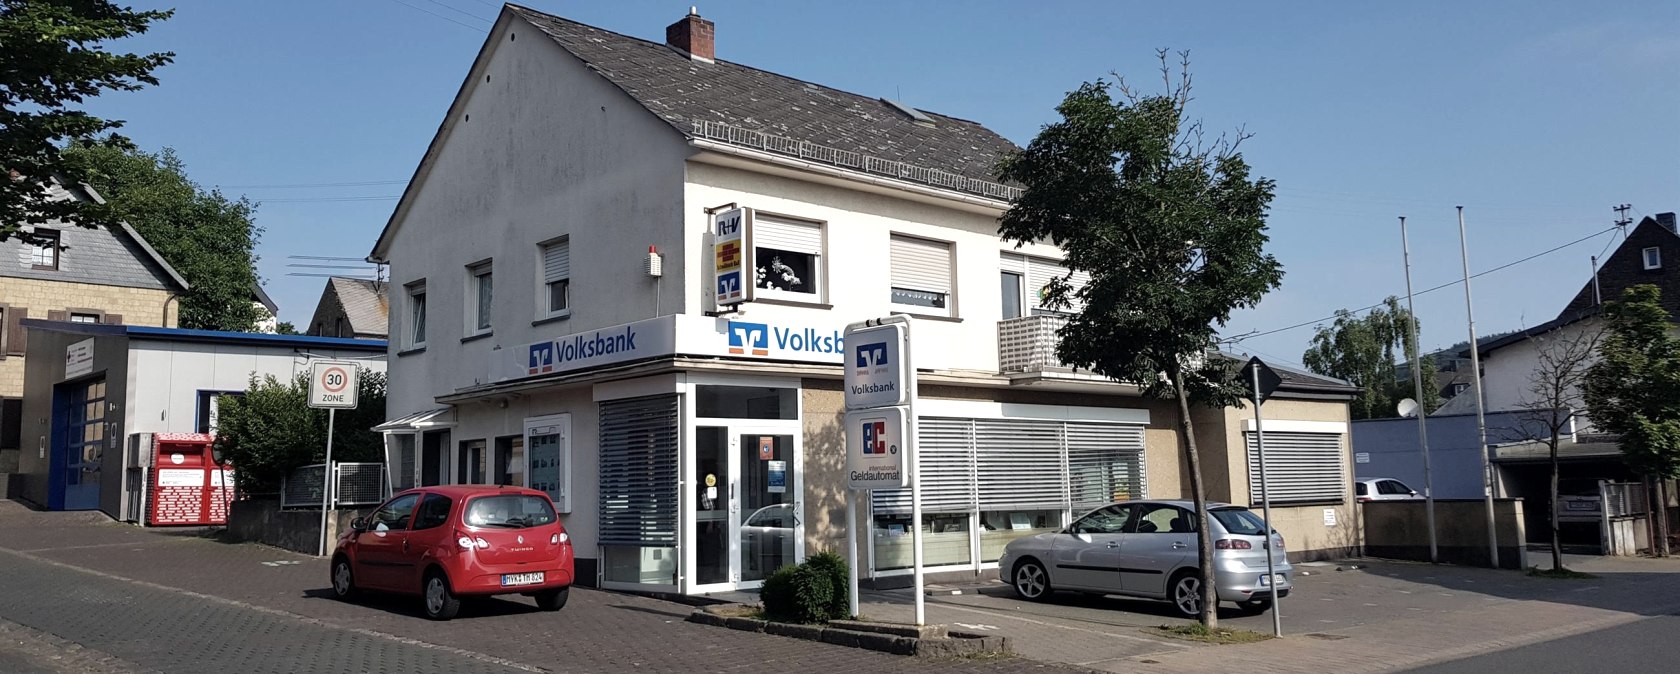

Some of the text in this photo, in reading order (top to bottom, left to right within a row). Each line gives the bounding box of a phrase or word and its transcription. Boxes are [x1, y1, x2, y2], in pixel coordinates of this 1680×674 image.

[718, 216, 740, 236] R+V
[556, 326, 636, 362] Volksbank
[773, 326, 845, 354] Volksb
[327, 374, 342, 385] 30
[851, 380, 895, 395] Volksbank
[322, 394, 344, 402] ZONE
[850, 470, 900, 481] Geldautomat
